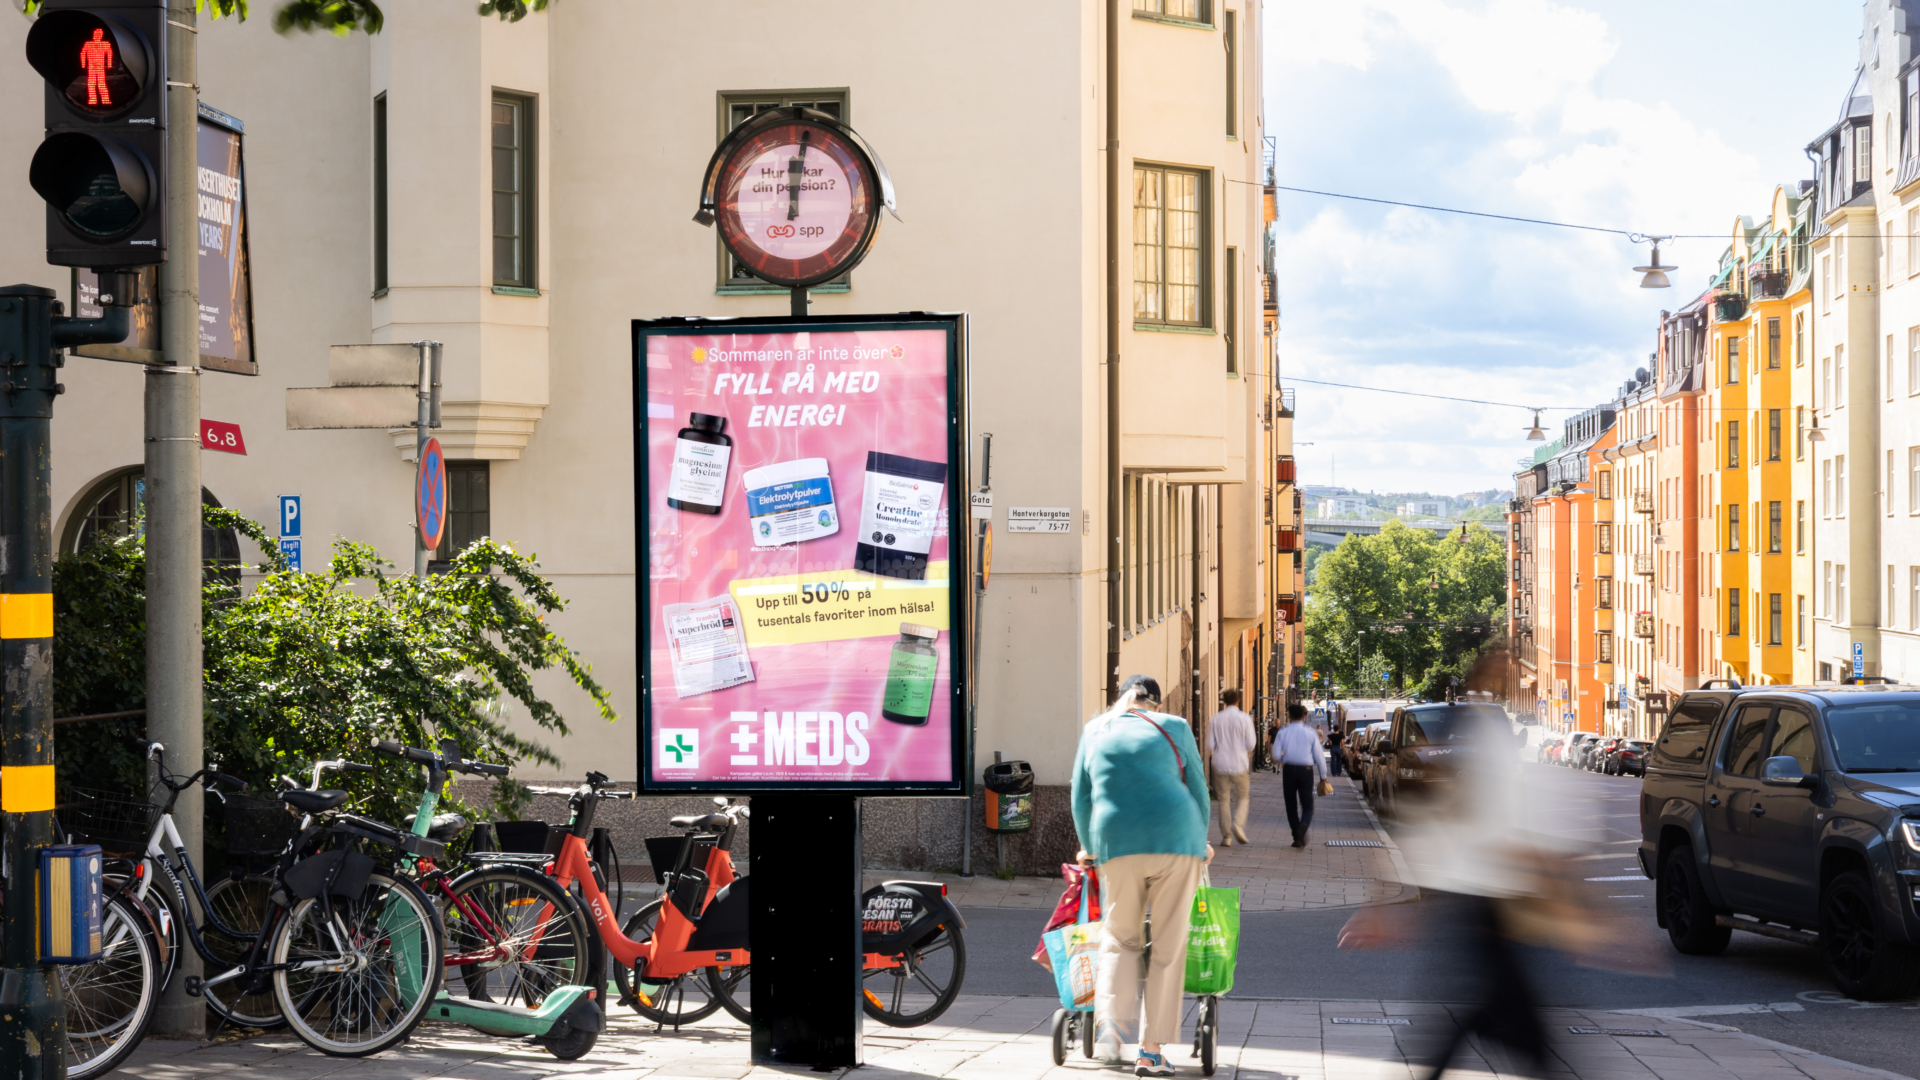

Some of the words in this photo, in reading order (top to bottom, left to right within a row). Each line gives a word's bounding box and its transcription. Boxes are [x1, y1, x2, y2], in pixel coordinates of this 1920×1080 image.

[761, 168, 784, 178] Hur
[198, 166, 241, 202] NSERTHUSET
[752, 181, 773, 192] din
[776, 178, 836, 194] pesion?
[198, 194, 232, 226] OCKHOLM
[199, 222, 223, 250] YEARS
[799, 225, 824, 238] spp
[708, 348, 793, 362] Sommaren
[797, 346, 814, 361] är
[819, 346, 848, 360] inte
[853, 346, 888, 360] över
[714, 373, 773, 395] FYLL
[782, 363, 815, 394] PÅ
[824, 371, 880, 393] MED
[747, 404, 846, 428] ENERGI
[679, 458, 722, 470] magnesium
[690, 467, 721, 477] glycinat
[759, 488, 821, 505] Elektrolytpulver
[972, 495, 990, 504] Gata
[285, 500, 298, 533] P
[877, 502, 922, 517] Creatine
[1012, 509, 1070, 519] Hantverkargatan
[876, 513, 922, 526] Monohydrate
[283, 542, 299, 551] Avgift
[756, 597, 780, 611] Upp
[783, 594, 798, 607] till
[801, 580, 850, 605] 50%
[857, 587, 871, 602] på
[696, 613, 719, 622] tranbär
[758, 612, 811, 627] tusentals
[814, 608, 865, 623] favoriter
[868, 605, 897, 618] inom
[900, 601, 934, 615] hälsa!
[678, 619, 721, 635] superbröd
[1855, 643, 1861, 655] P
[897, 661, 928, 671] Magnesium
[764, 711, 870, 766] MEDS
[868, 896, 913, 909] FÖRSTA
[396, 952, 407, 976] Bolt
